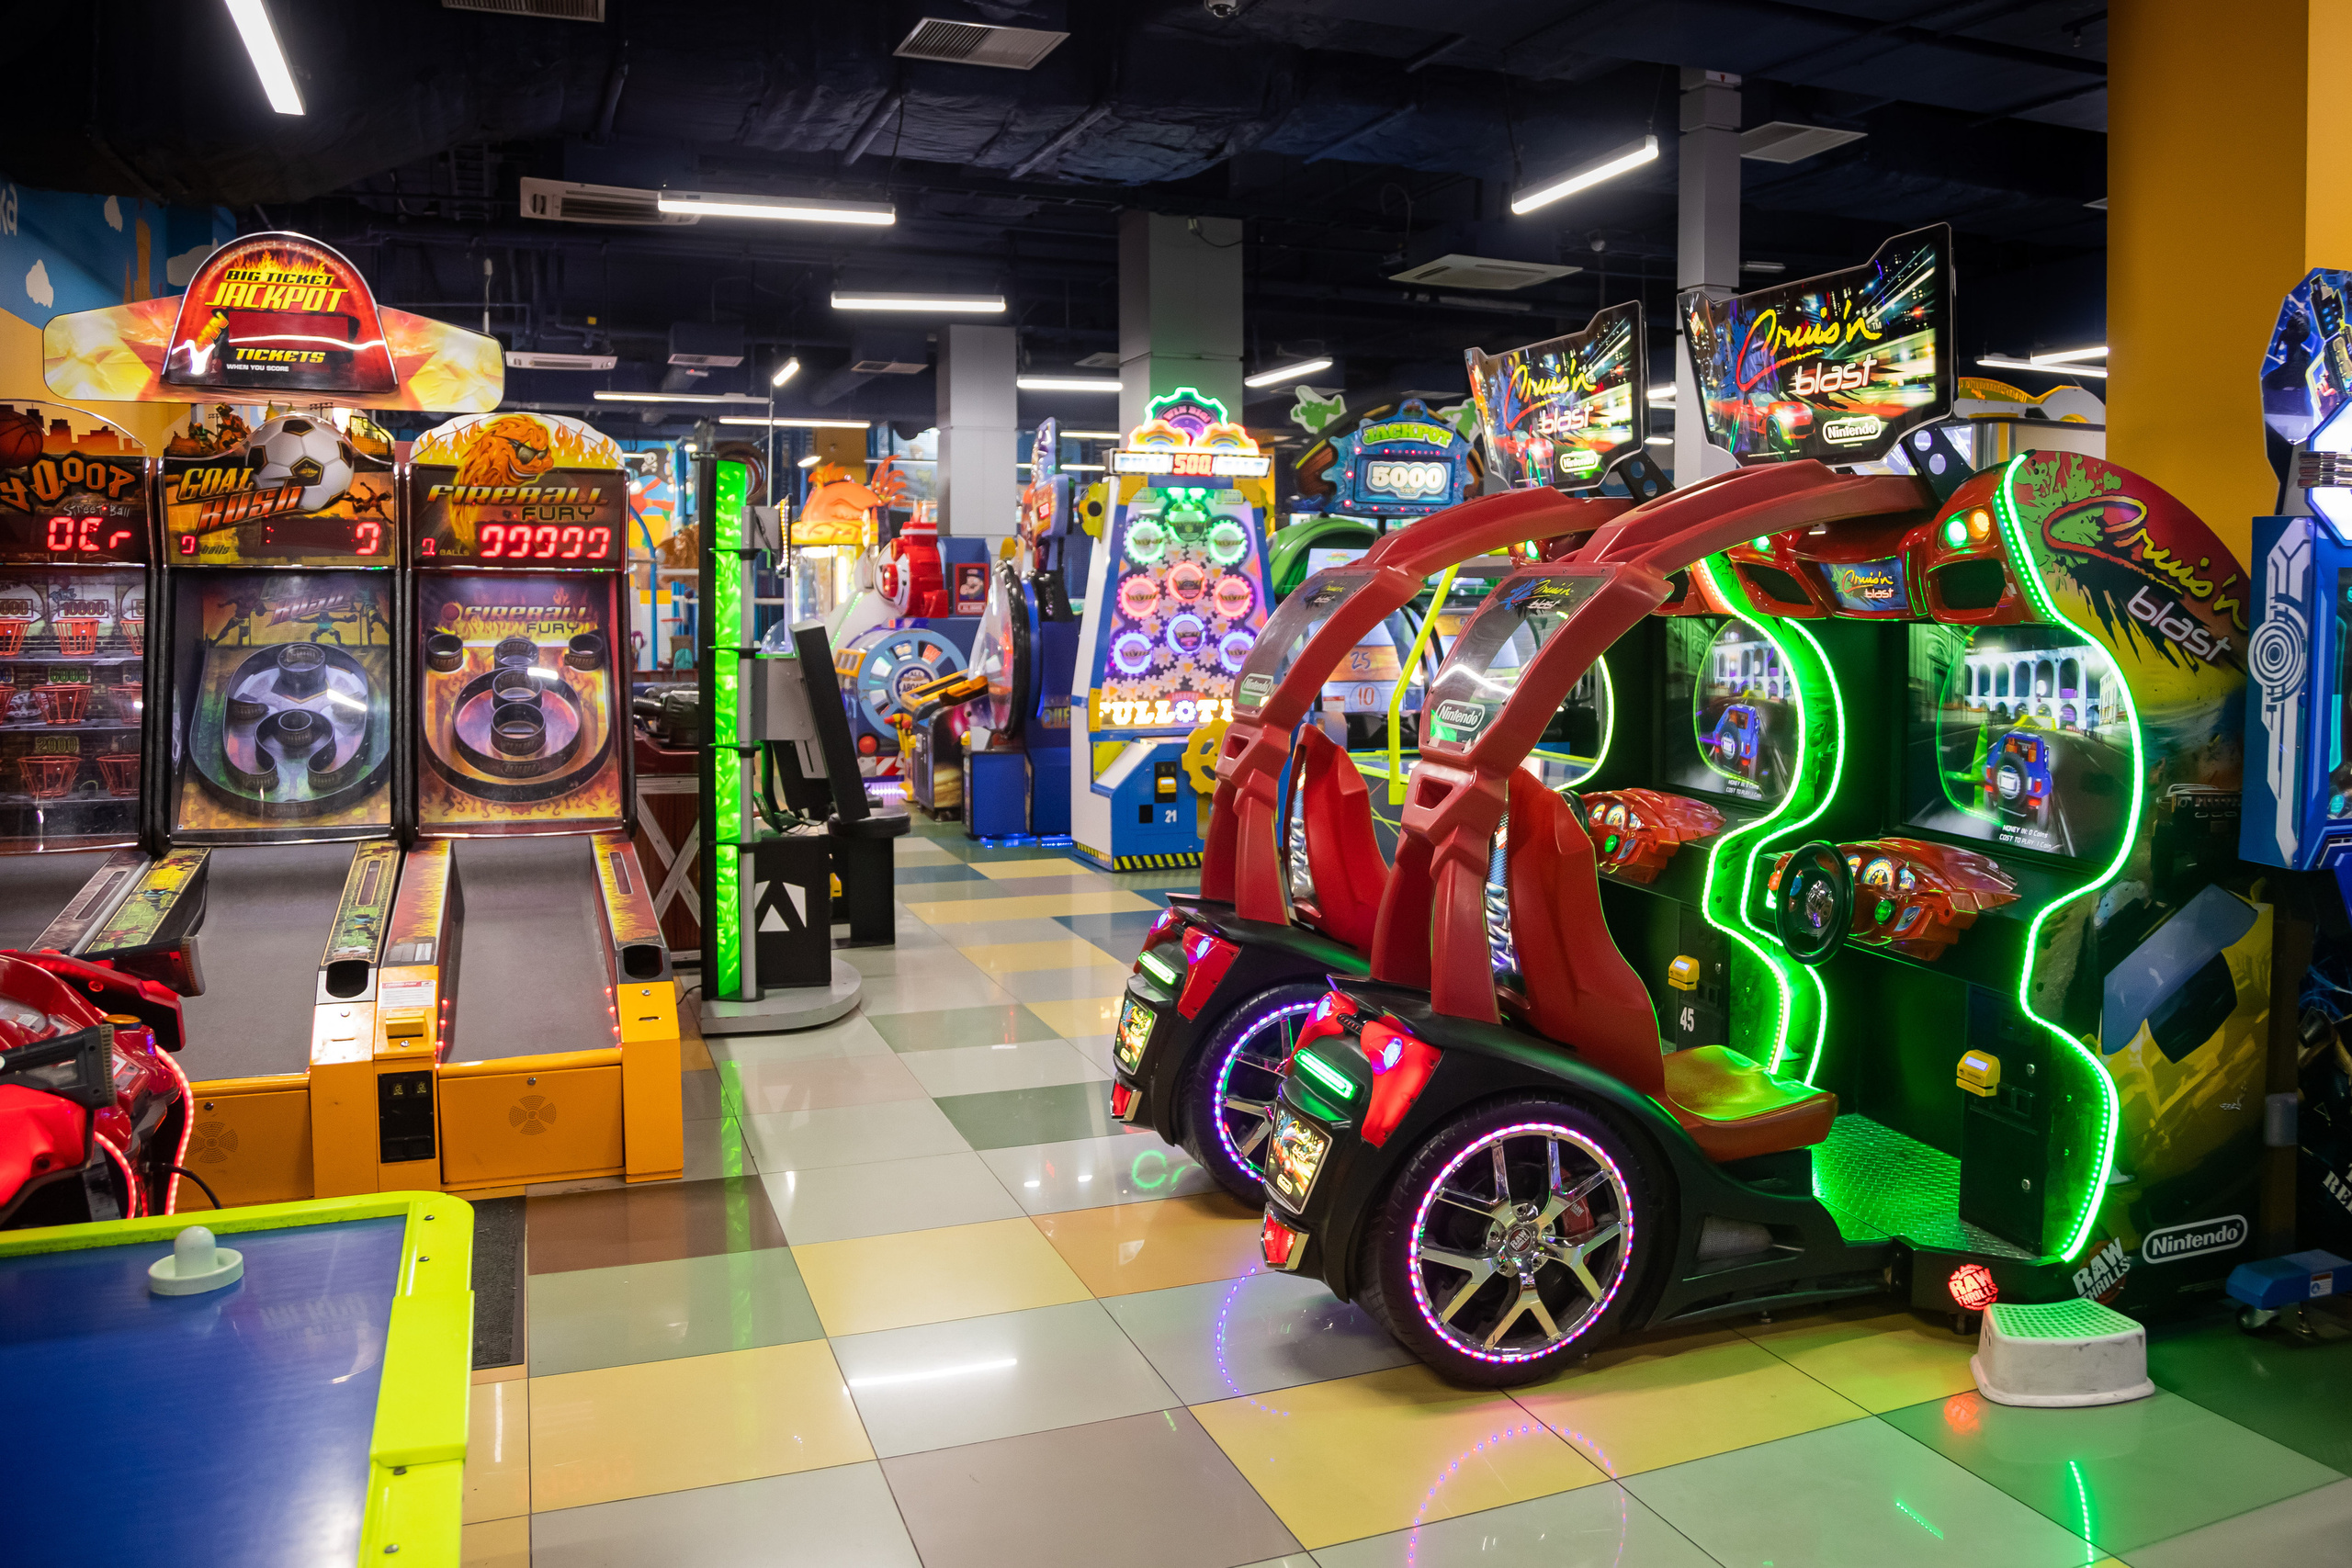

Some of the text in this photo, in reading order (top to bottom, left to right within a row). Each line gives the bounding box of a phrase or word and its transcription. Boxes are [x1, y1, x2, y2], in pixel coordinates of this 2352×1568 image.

[226, 270, 335, 286] BIG TICKET
[205, 282, 349, 312] JACKPOT
[235, 347, 326, 364] TICKETS
[1794, 354, 1877, 396] blast
[1540, 401, 1594, 434] blast
[1363, 423, 1452, 447] JACKPOT
[1826, 423, 1877, 439] Nintendo
[180, 468, 254, 500] GOAL
[1372, 466, 1442, 489] 5000
[109, 504, 130, 517] Ball
[521, 506, 595, 521] FURY
[439, 548, 469, 557] BALLS
[1865, 588, 1894, 599] blast
[526, 623, 580, 634] FURY
[2127, 585, 2232, 661] blast
[1351, 650, 1371, 670] 25
[1358, 687, 1374, 706] 10
[1438, 705, 1478, 726] Nintendo
[36, 737, 78, 752] 2000
[1165, 809, 1177, 823] 21
[1998, 833, 2014, 841] COST
[2002, 824, 2020, 834] MONEY
[2033, 829, 2049, 839] Coins
[1679, 1006, 1695, 1032] 45
[2152, 1225, 2238, 1256] Nintendo
[2073, 1236, 2124, 1296] RAW
[1948, 1268, 1994, 1298] RAW
